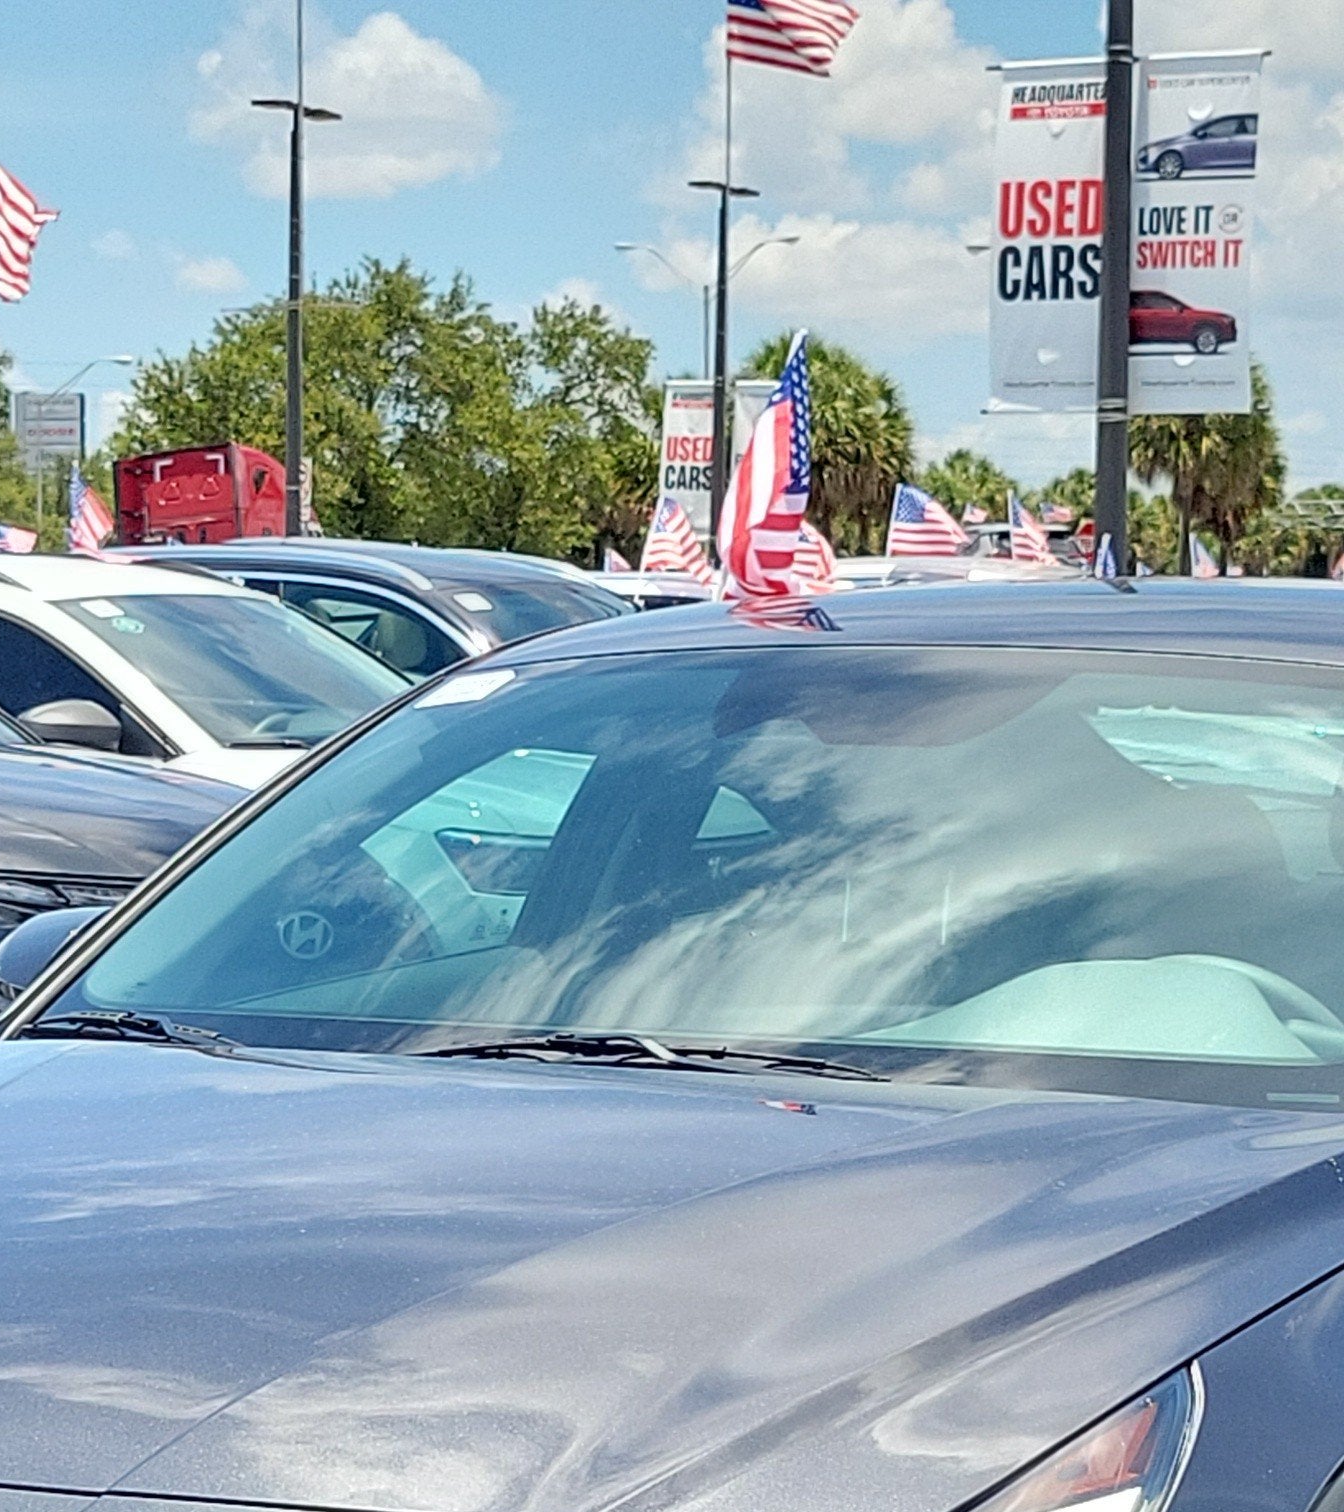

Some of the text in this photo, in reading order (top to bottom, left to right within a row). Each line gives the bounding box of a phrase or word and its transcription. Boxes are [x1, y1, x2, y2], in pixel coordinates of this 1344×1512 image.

[1000, 180, 1104, 239] USED
[1138, 206, 1186, 236] LOVE
[1194, 205, 1213, 235] IT
[1136, 239, 1243, 270] SWITCH IT
[998, 243, 1102, 301] CARS
[666, 436, 714, 463] USED
[664, 465, 713, 491] CARS
